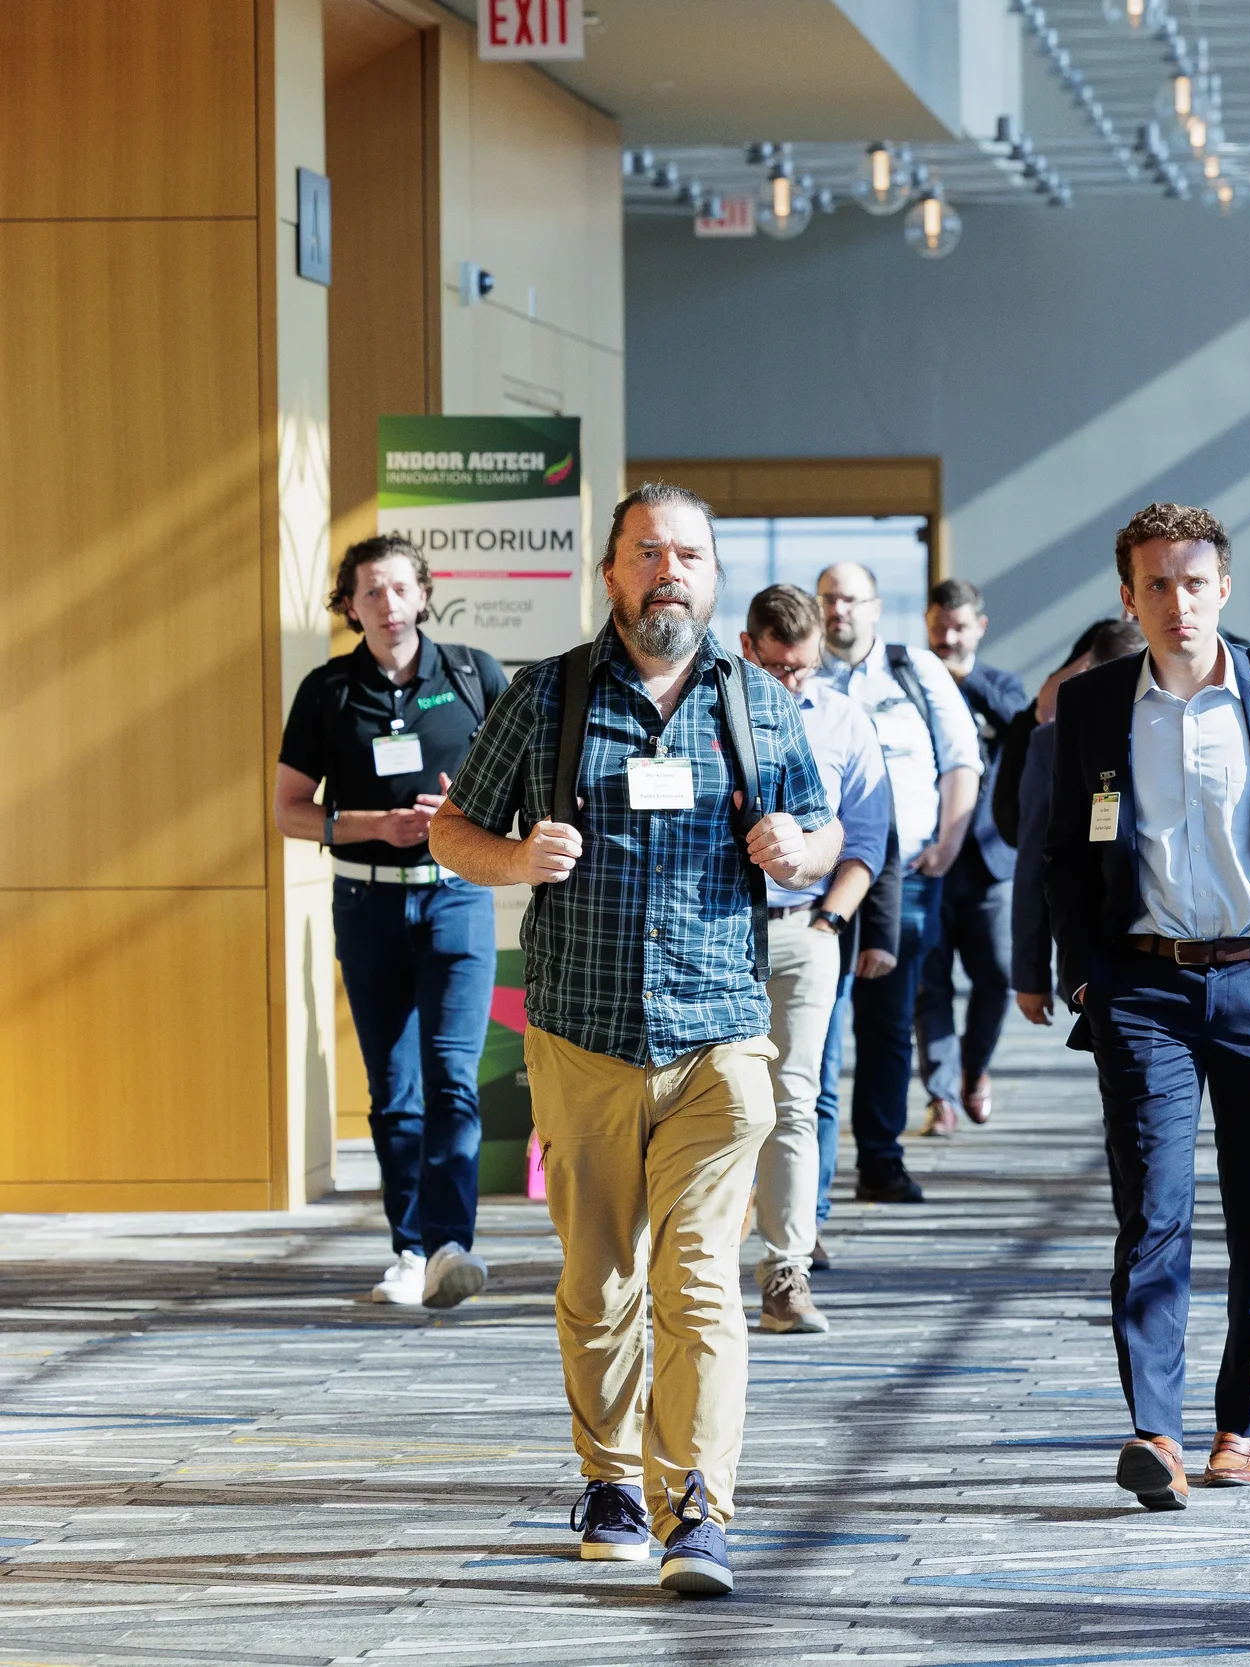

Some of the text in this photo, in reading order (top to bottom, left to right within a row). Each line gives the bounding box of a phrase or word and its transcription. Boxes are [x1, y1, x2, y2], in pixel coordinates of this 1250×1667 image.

[489, 0, 567, 45] EXIT
[386, 451, 545, 471] INDOOR AGTECH
[386, 472, 529, 485] INNOVATION SUMMIT
[473, 600, 532, 612] vertical
[474, 615, 521, 628] future
